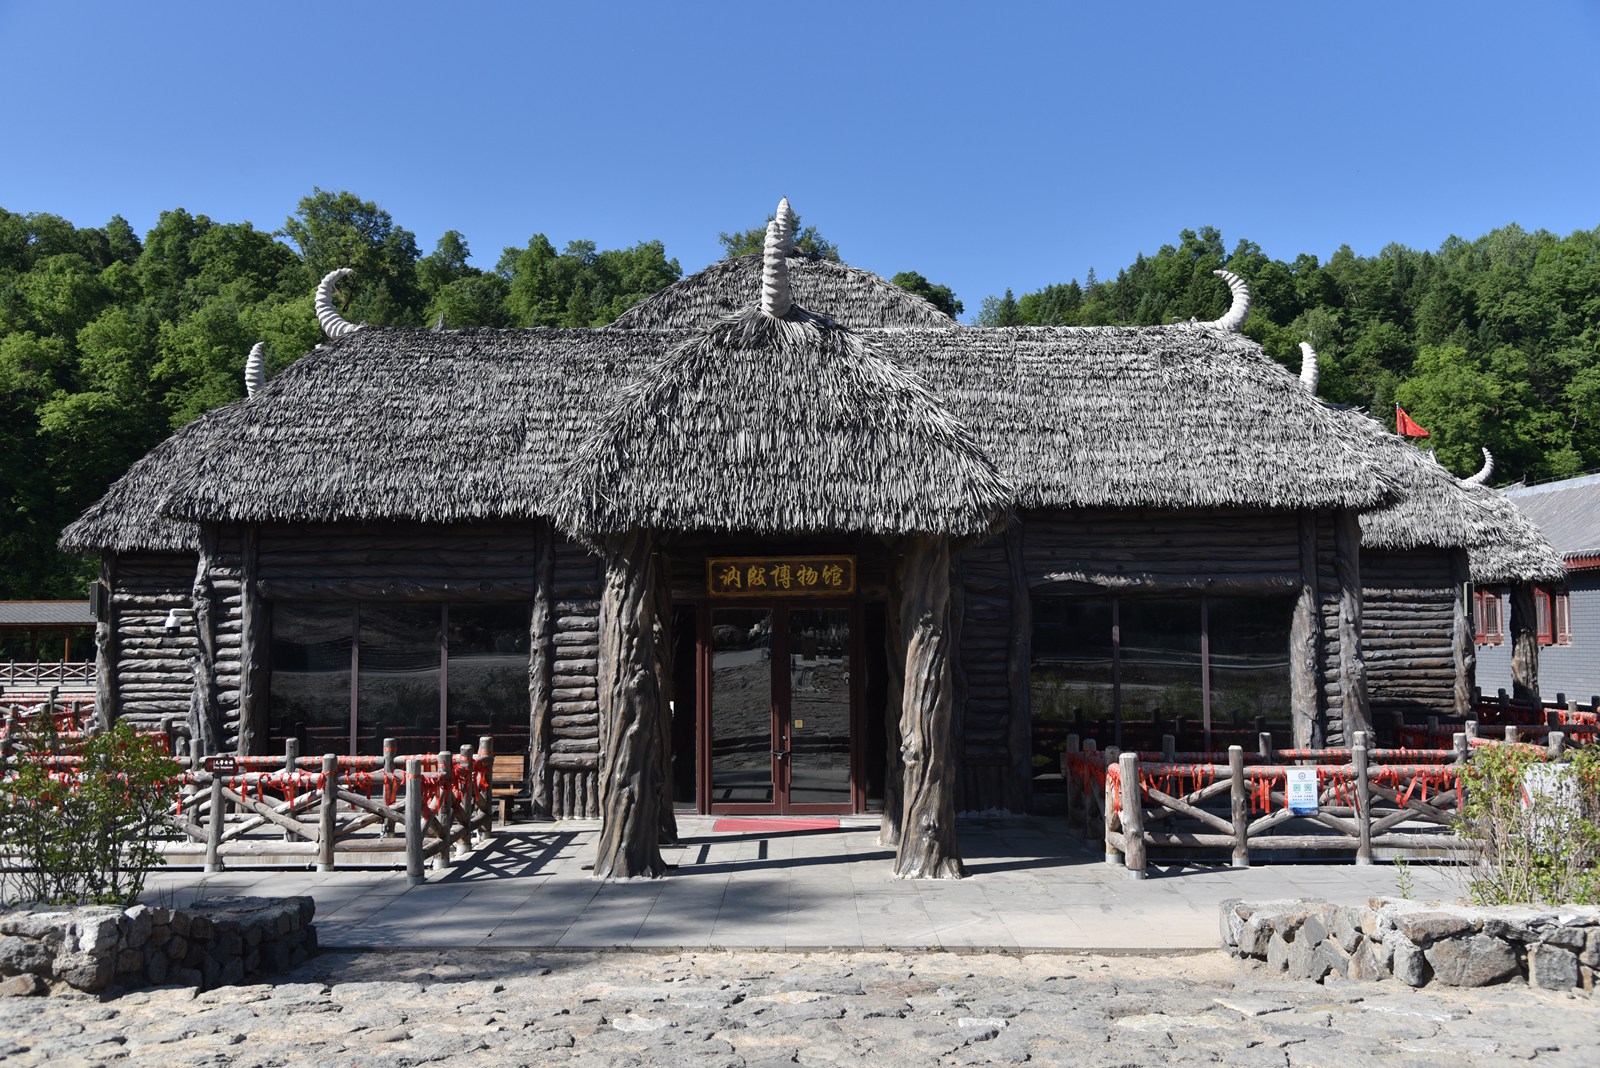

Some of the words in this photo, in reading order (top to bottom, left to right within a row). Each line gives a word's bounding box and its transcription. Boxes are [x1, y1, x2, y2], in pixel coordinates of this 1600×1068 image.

[719, 564, 844, 589] 讷殷博物馆
